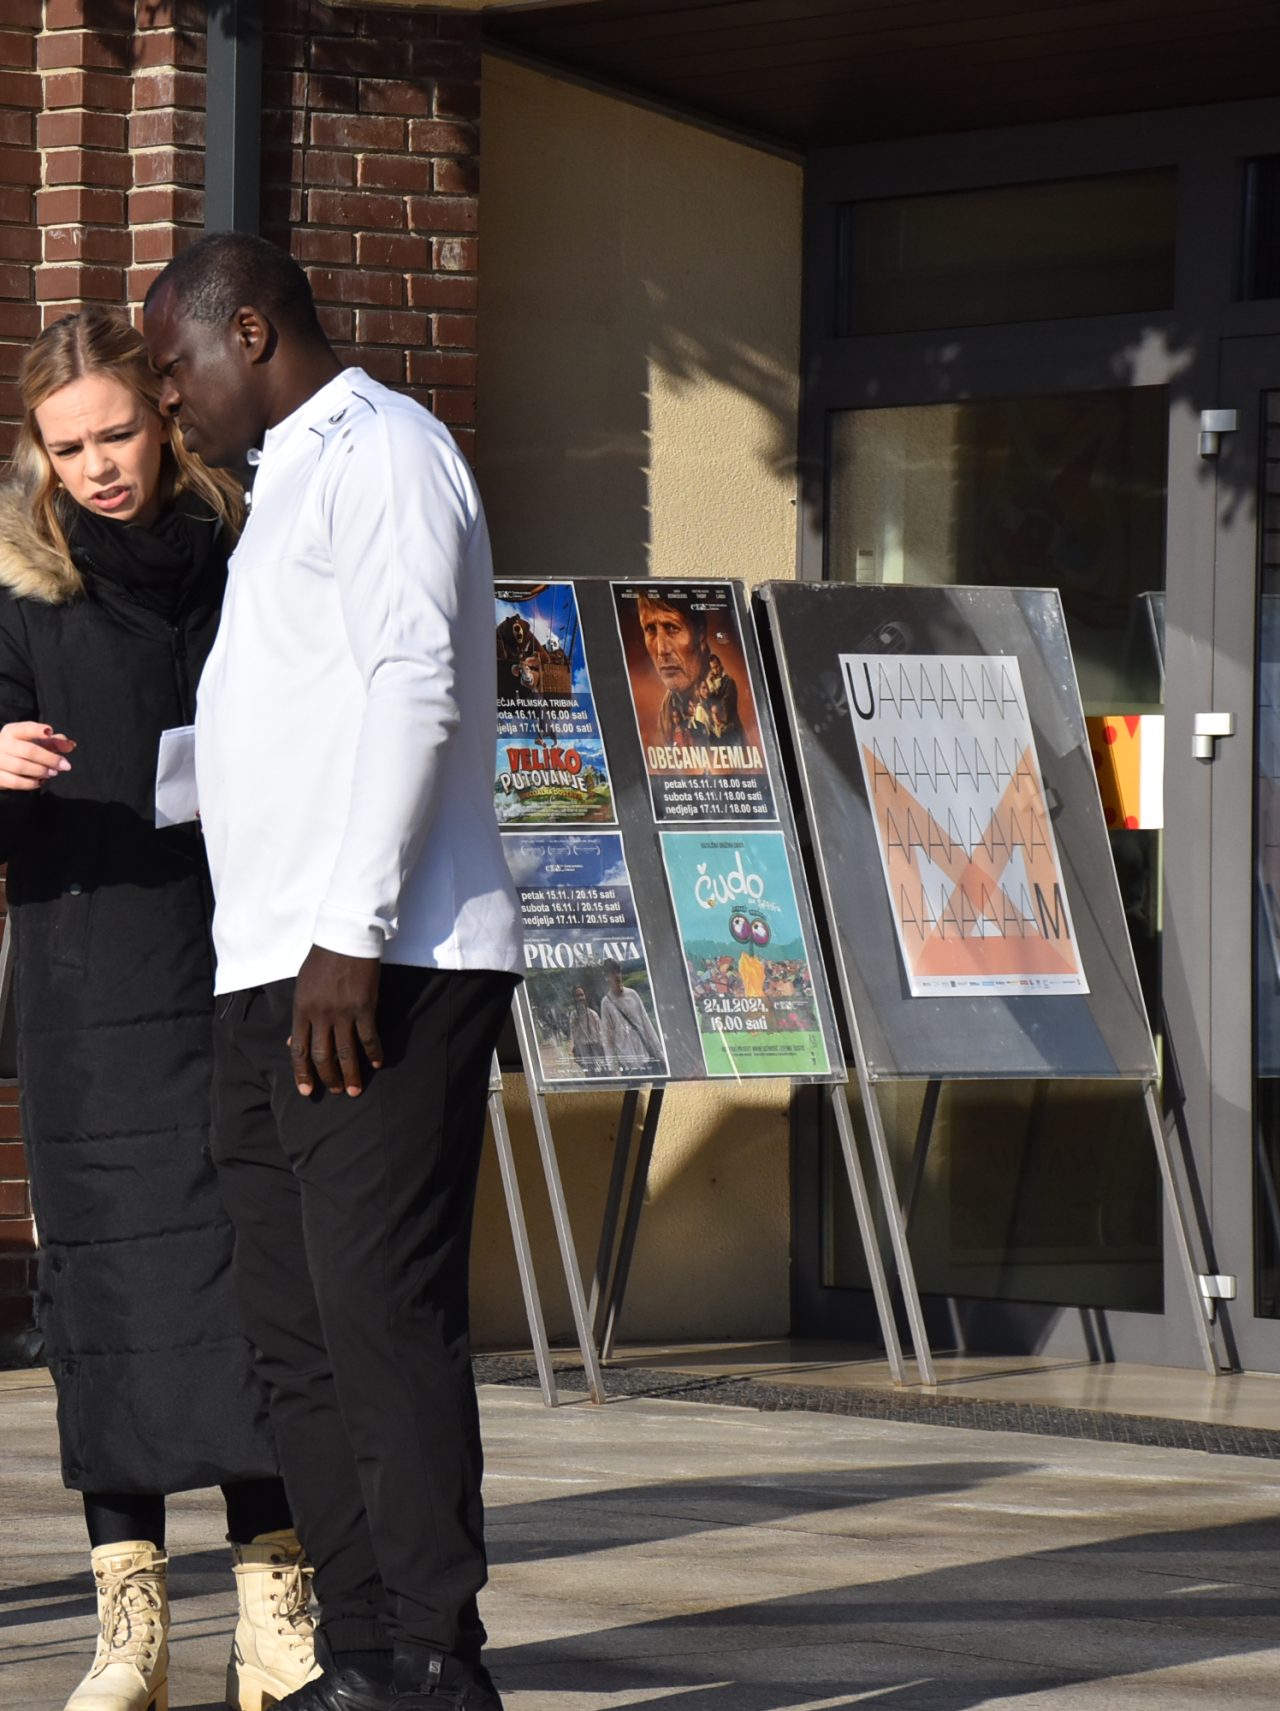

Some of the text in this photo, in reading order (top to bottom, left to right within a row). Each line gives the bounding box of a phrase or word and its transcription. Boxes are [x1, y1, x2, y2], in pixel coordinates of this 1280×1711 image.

[516, 699, 548, 707] FILMSKA
[549, 699, 579, 707] TRIBINA
[546, 710, 570, 720] 16.00
[572, 710, 588, 720] sati
[551, 723, 574, 733] 16.00
[576, 723, 592, 733] sati
[647, 741, 763, 769] OBEĆANA ZEMLJA
[506, 747, 582, 775] VELIKO
[500, 770, 588, 795] PUTOVANJE
[664, 779, 687, 790] petak
[688, 779, 712, 789] 15.11.
[719, 779, 740, 788] 18.00
[742, 779, 757, 788] sati
[663, 792, 692, 801] subota
[724, 791, 745, 801] 18.00
[747, 791, 762, 801] sati
[665, 804, 698, 815] nedjelja
[700, 804, 723, 814] 17.11.
[729, 804, 751, 813] 18.00
[752, 803, 768, 813] sati
[521, 890, 545, 901] petak
[546, 890, 570, 900] 15.11.
[575, 890, 598, 899] 20.15
[600, 889, 615, 899] sati
[521, 903, 550, 912] subota
[551, 902, 575, 912] 16.11.
[581, 902, 603, 911] 20.15
[605, 902, 621, 911] sati
[555, 915, 580, 924] 17.11.
[586, 914, 608, 924] 20.15
[610, 914, 626, 923] sati
[710, 1015, 743, 1031] 16.00
[745, 1016, 768, 1030] sati
